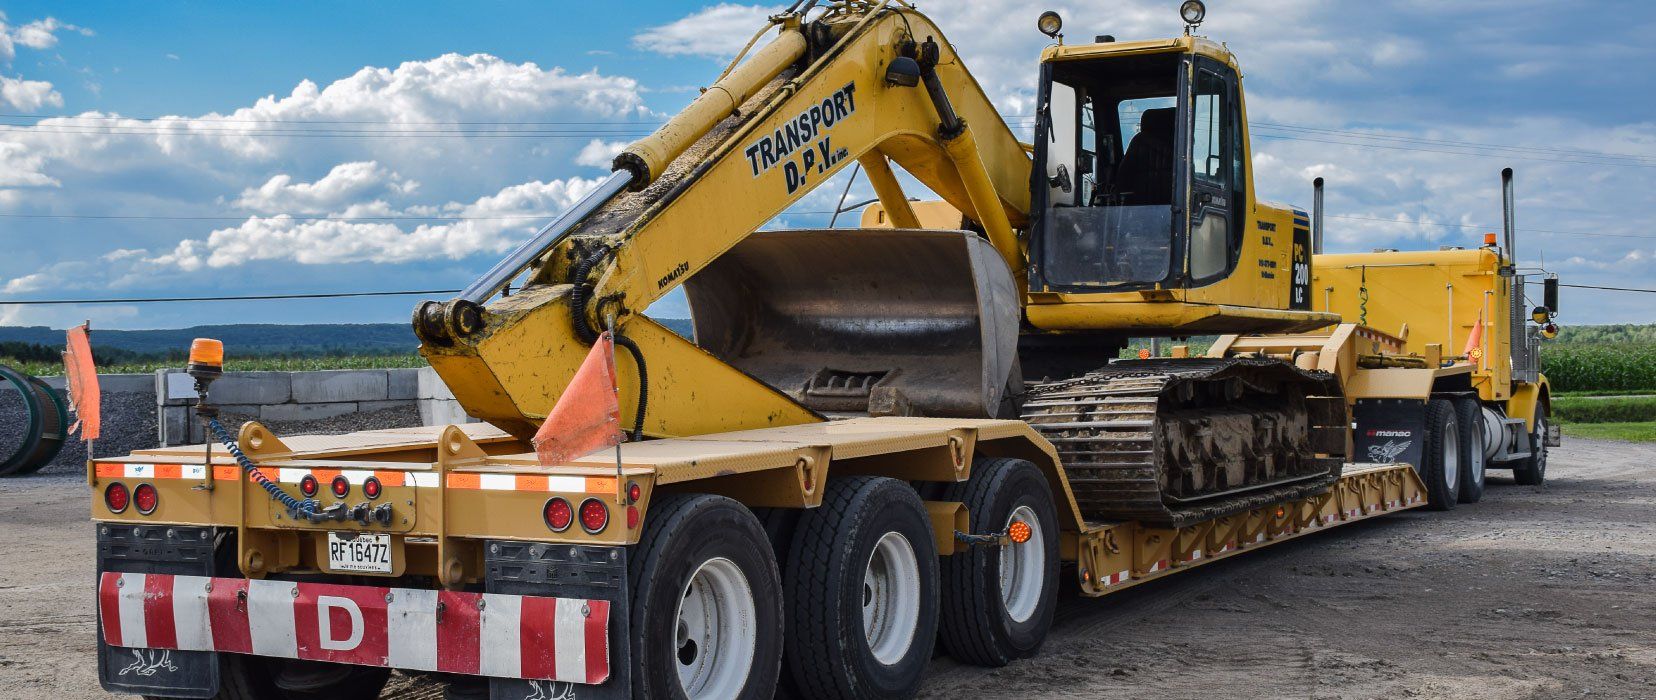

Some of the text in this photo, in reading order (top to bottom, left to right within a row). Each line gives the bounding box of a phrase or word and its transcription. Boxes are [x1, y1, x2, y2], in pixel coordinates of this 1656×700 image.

[745, 80, 856, 176] TRANSPORT
[1294, 243, 1304, 262] PC
[657, 261, 690, 290] KOMATSU
[1294, 262, 1309, 286] 200
[1295, 286, 1303, 304] LC
[331, 541, 389, 564] RF1647Z
[317, 595, 365, 651] D
